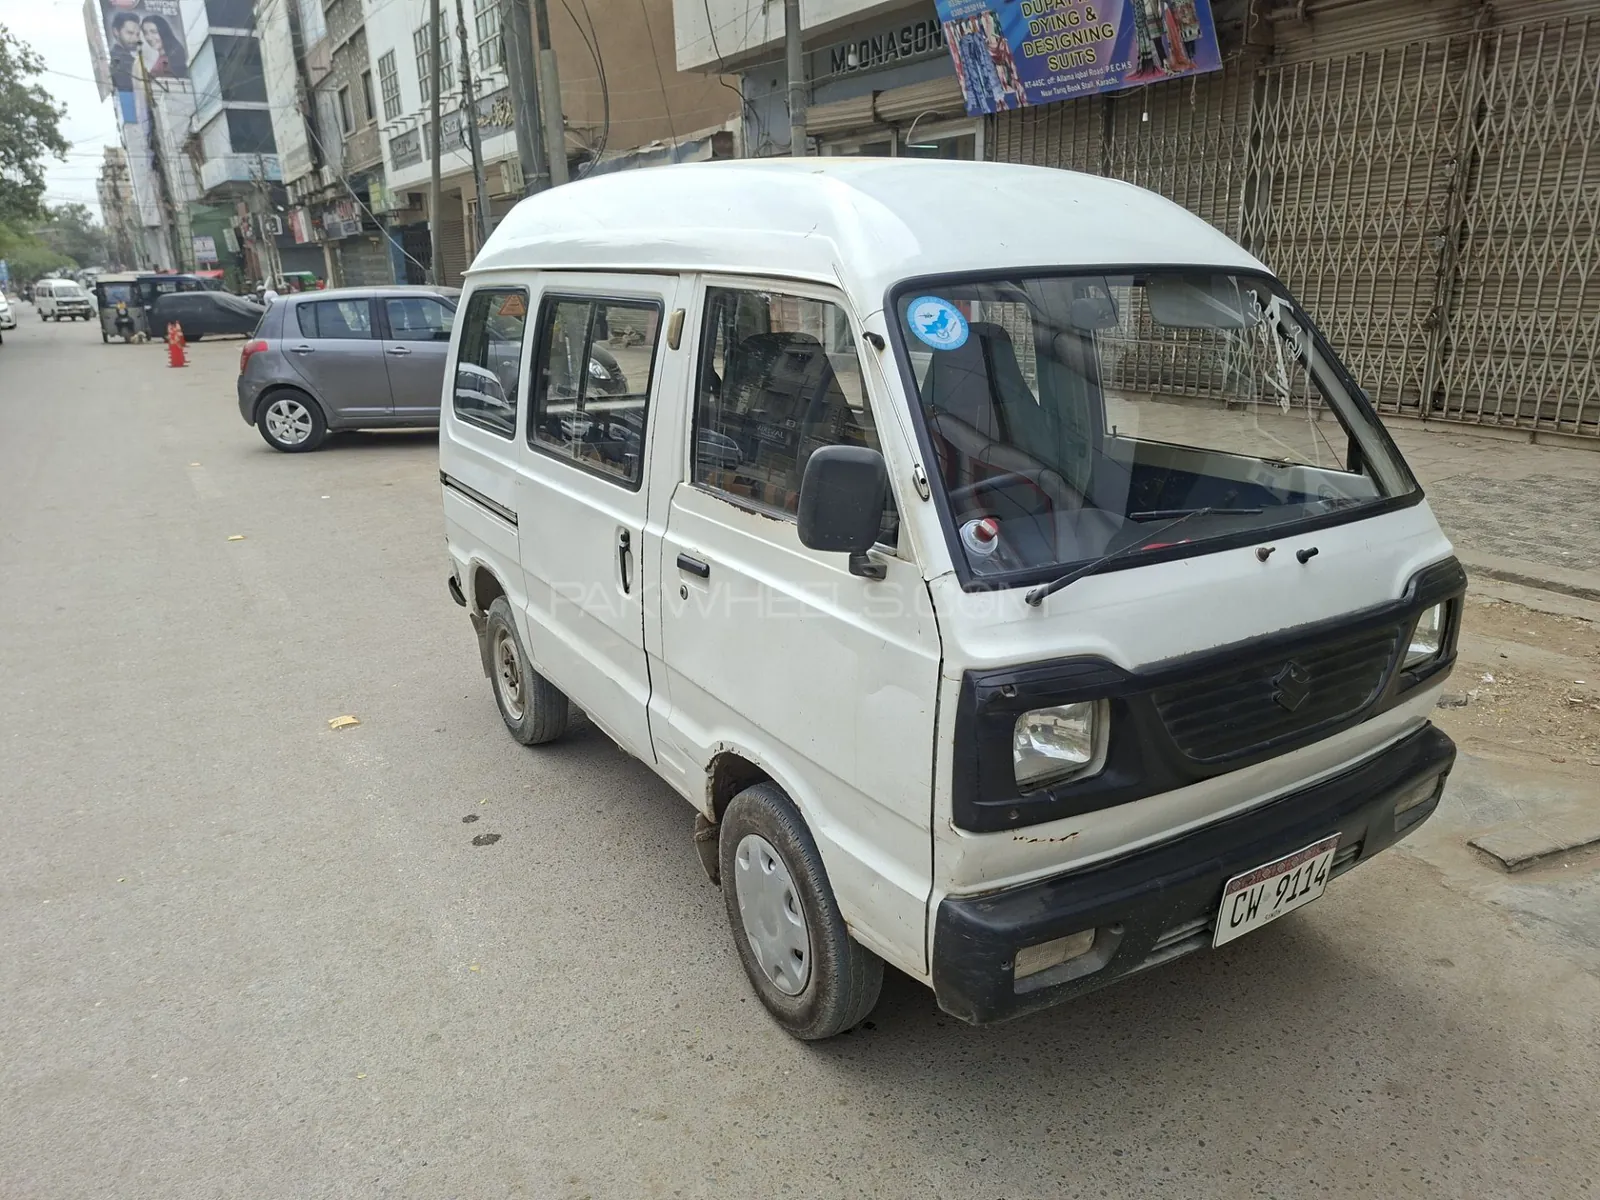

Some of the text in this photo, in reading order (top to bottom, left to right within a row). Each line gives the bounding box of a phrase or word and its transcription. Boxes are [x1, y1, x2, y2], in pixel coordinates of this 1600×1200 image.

[1021, 0, 1090, 18] DUPA
[1029, 6, 1098, 36] DYING &
[831, 20, 948, 77] MOONASON
[1022, 22, 1115, 58] DESIGNING
[1048, 48, 1097, 72] SUITS
[1067, 82, 1081, 92] Book
[1230, 853, 1330, 928] CW 9114
